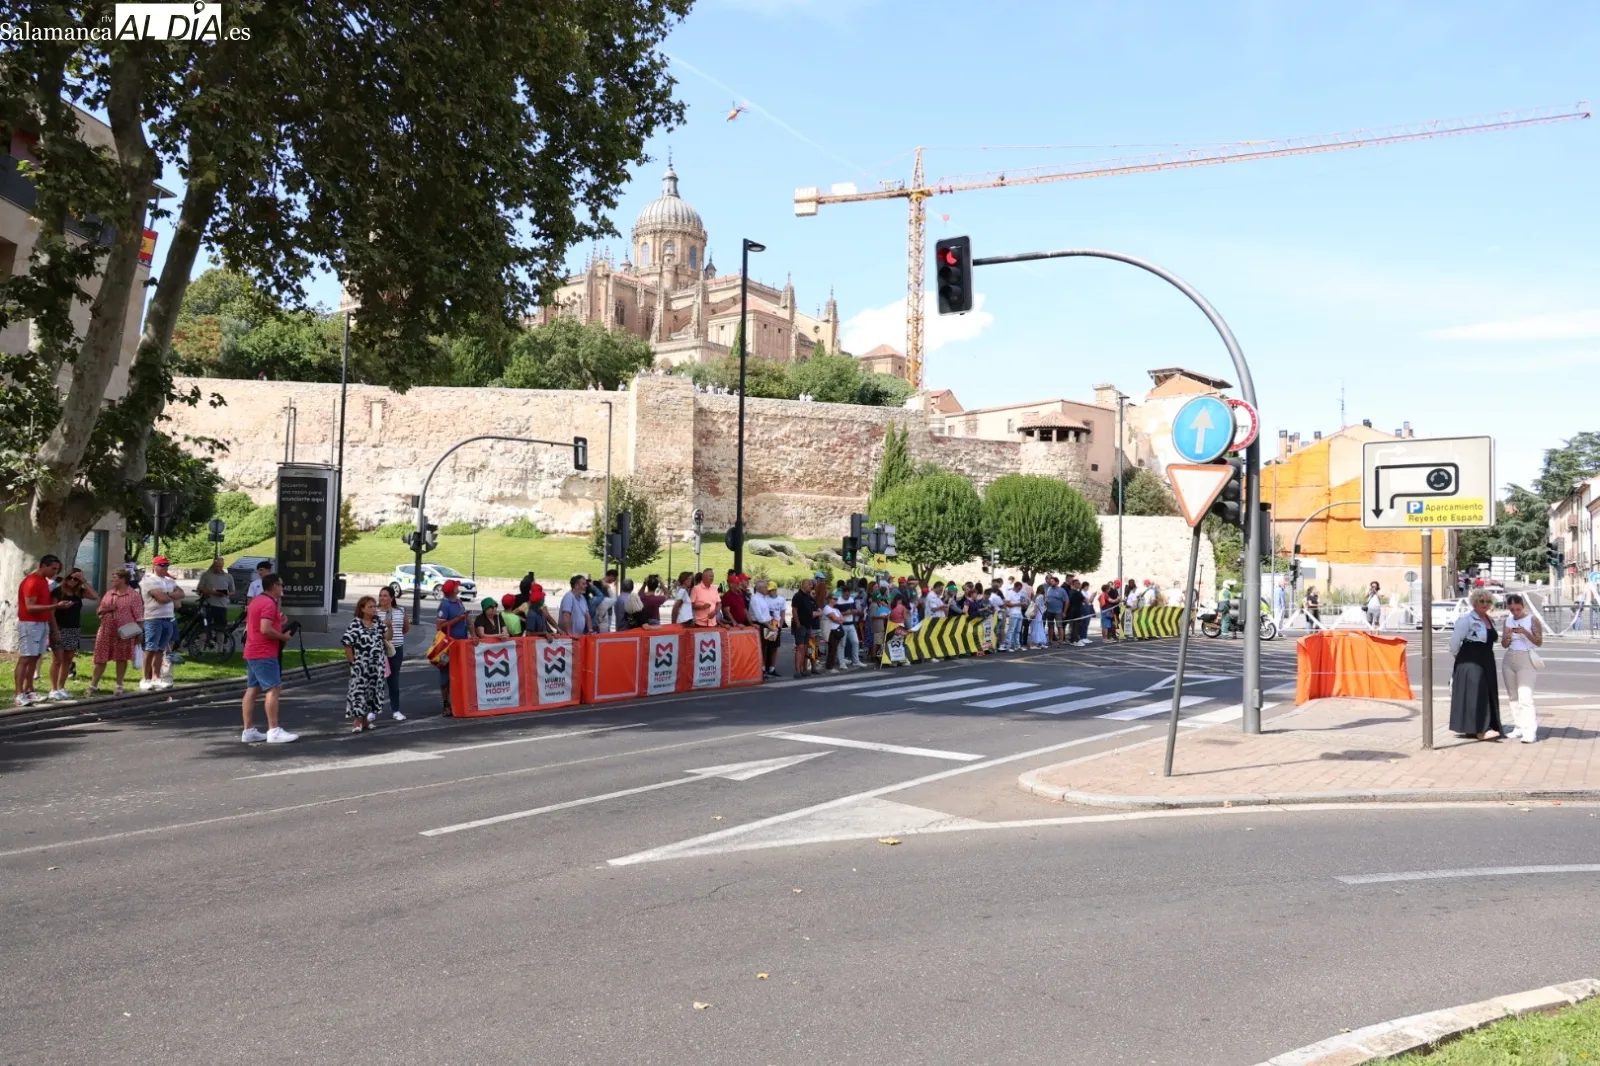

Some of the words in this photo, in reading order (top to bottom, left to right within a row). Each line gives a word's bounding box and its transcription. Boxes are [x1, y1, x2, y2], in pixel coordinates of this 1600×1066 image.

[1425, 502, 1484, 512] Aparcamiento
[1408, 513, 1435, 524] Reyes
[1437, 513, 1448, 522] de
[1450, 512, 1484, 523] España
